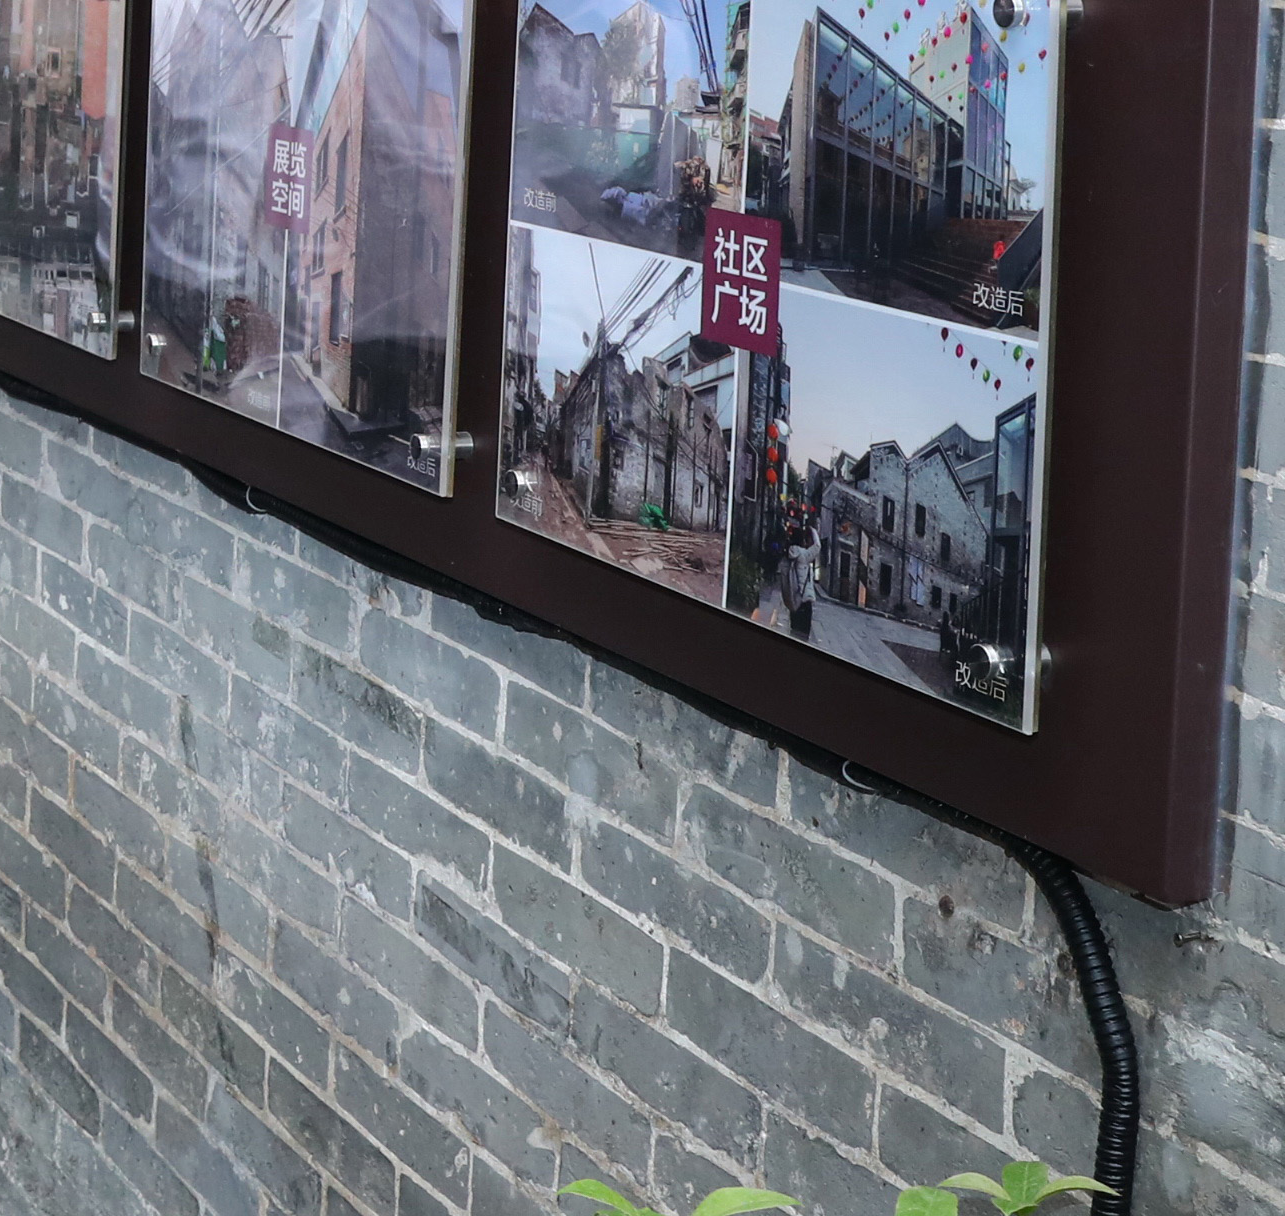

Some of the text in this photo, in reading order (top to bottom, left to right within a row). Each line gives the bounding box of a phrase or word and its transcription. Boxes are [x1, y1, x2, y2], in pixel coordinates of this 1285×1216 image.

[272, 138, 307, 178] 展览
[271, 178, 305, 219] 空间
[523, 187, 557, 213] 改造前
[713, 227, 768, 282] 社区
[711, 280, 767, 335] 广场
[972, 283, 1025, 317] 改造后
